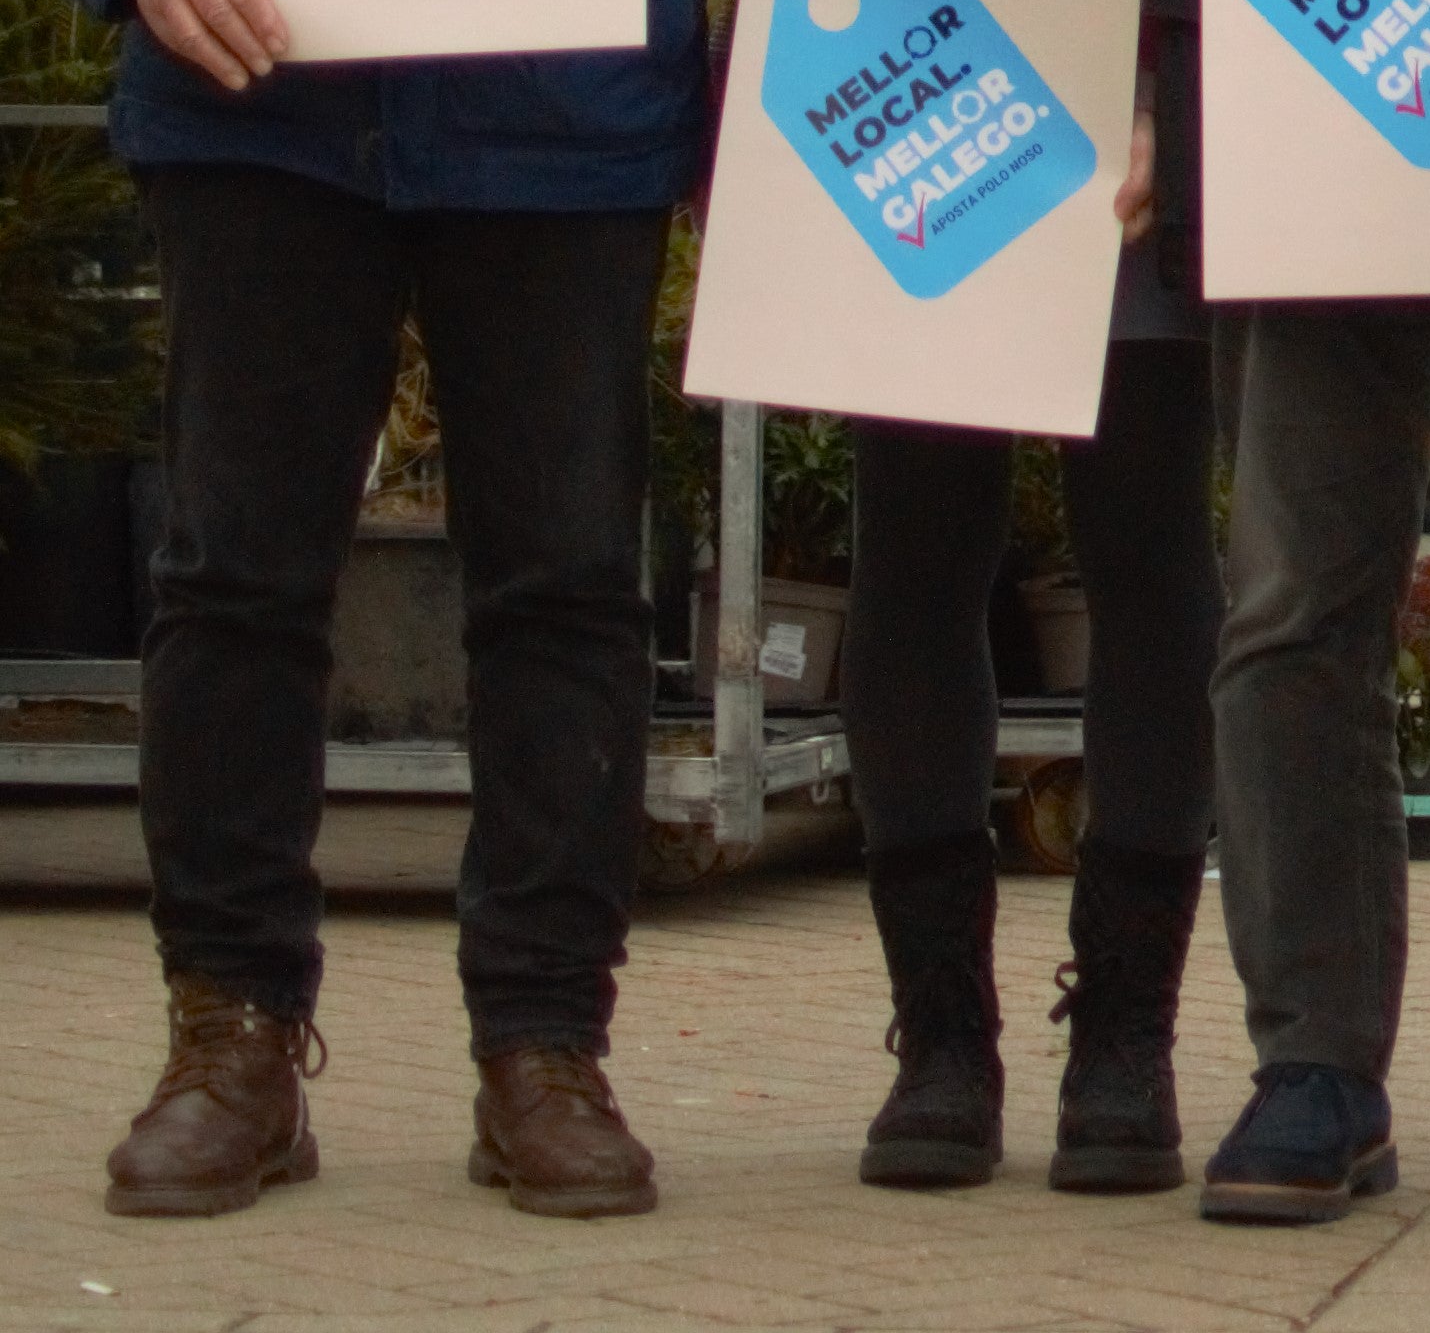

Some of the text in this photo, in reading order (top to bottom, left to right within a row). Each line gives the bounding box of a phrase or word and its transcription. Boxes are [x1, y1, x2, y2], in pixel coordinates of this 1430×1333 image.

[805, 4, 966, 136] MELLOR
[829, 63, 973, 169] LOCAL.
[853, 68, 1016, 202] MELLOR
[930, 142, 1044, 235] APOSTA POLO NOSO
